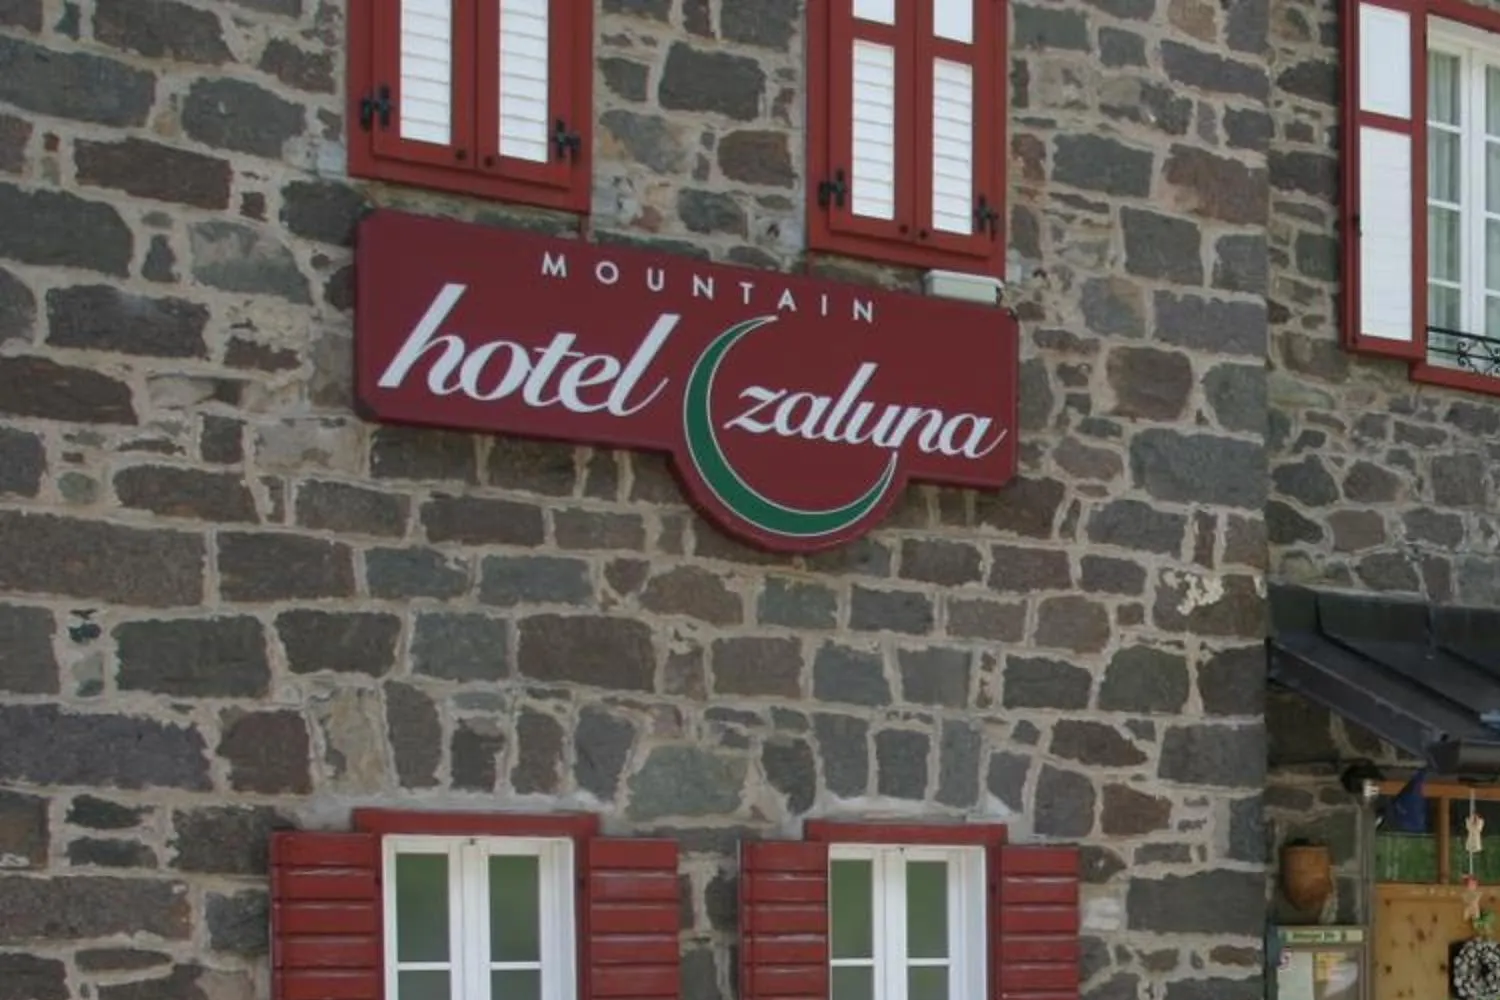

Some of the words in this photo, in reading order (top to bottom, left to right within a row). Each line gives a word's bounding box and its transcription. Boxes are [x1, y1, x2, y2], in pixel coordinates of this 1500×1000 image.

[541, 251, 873, 322] MOUNTAIN
[378, 283, 681, 416] hotel
[723, 362, 1007, 459] zaluna
